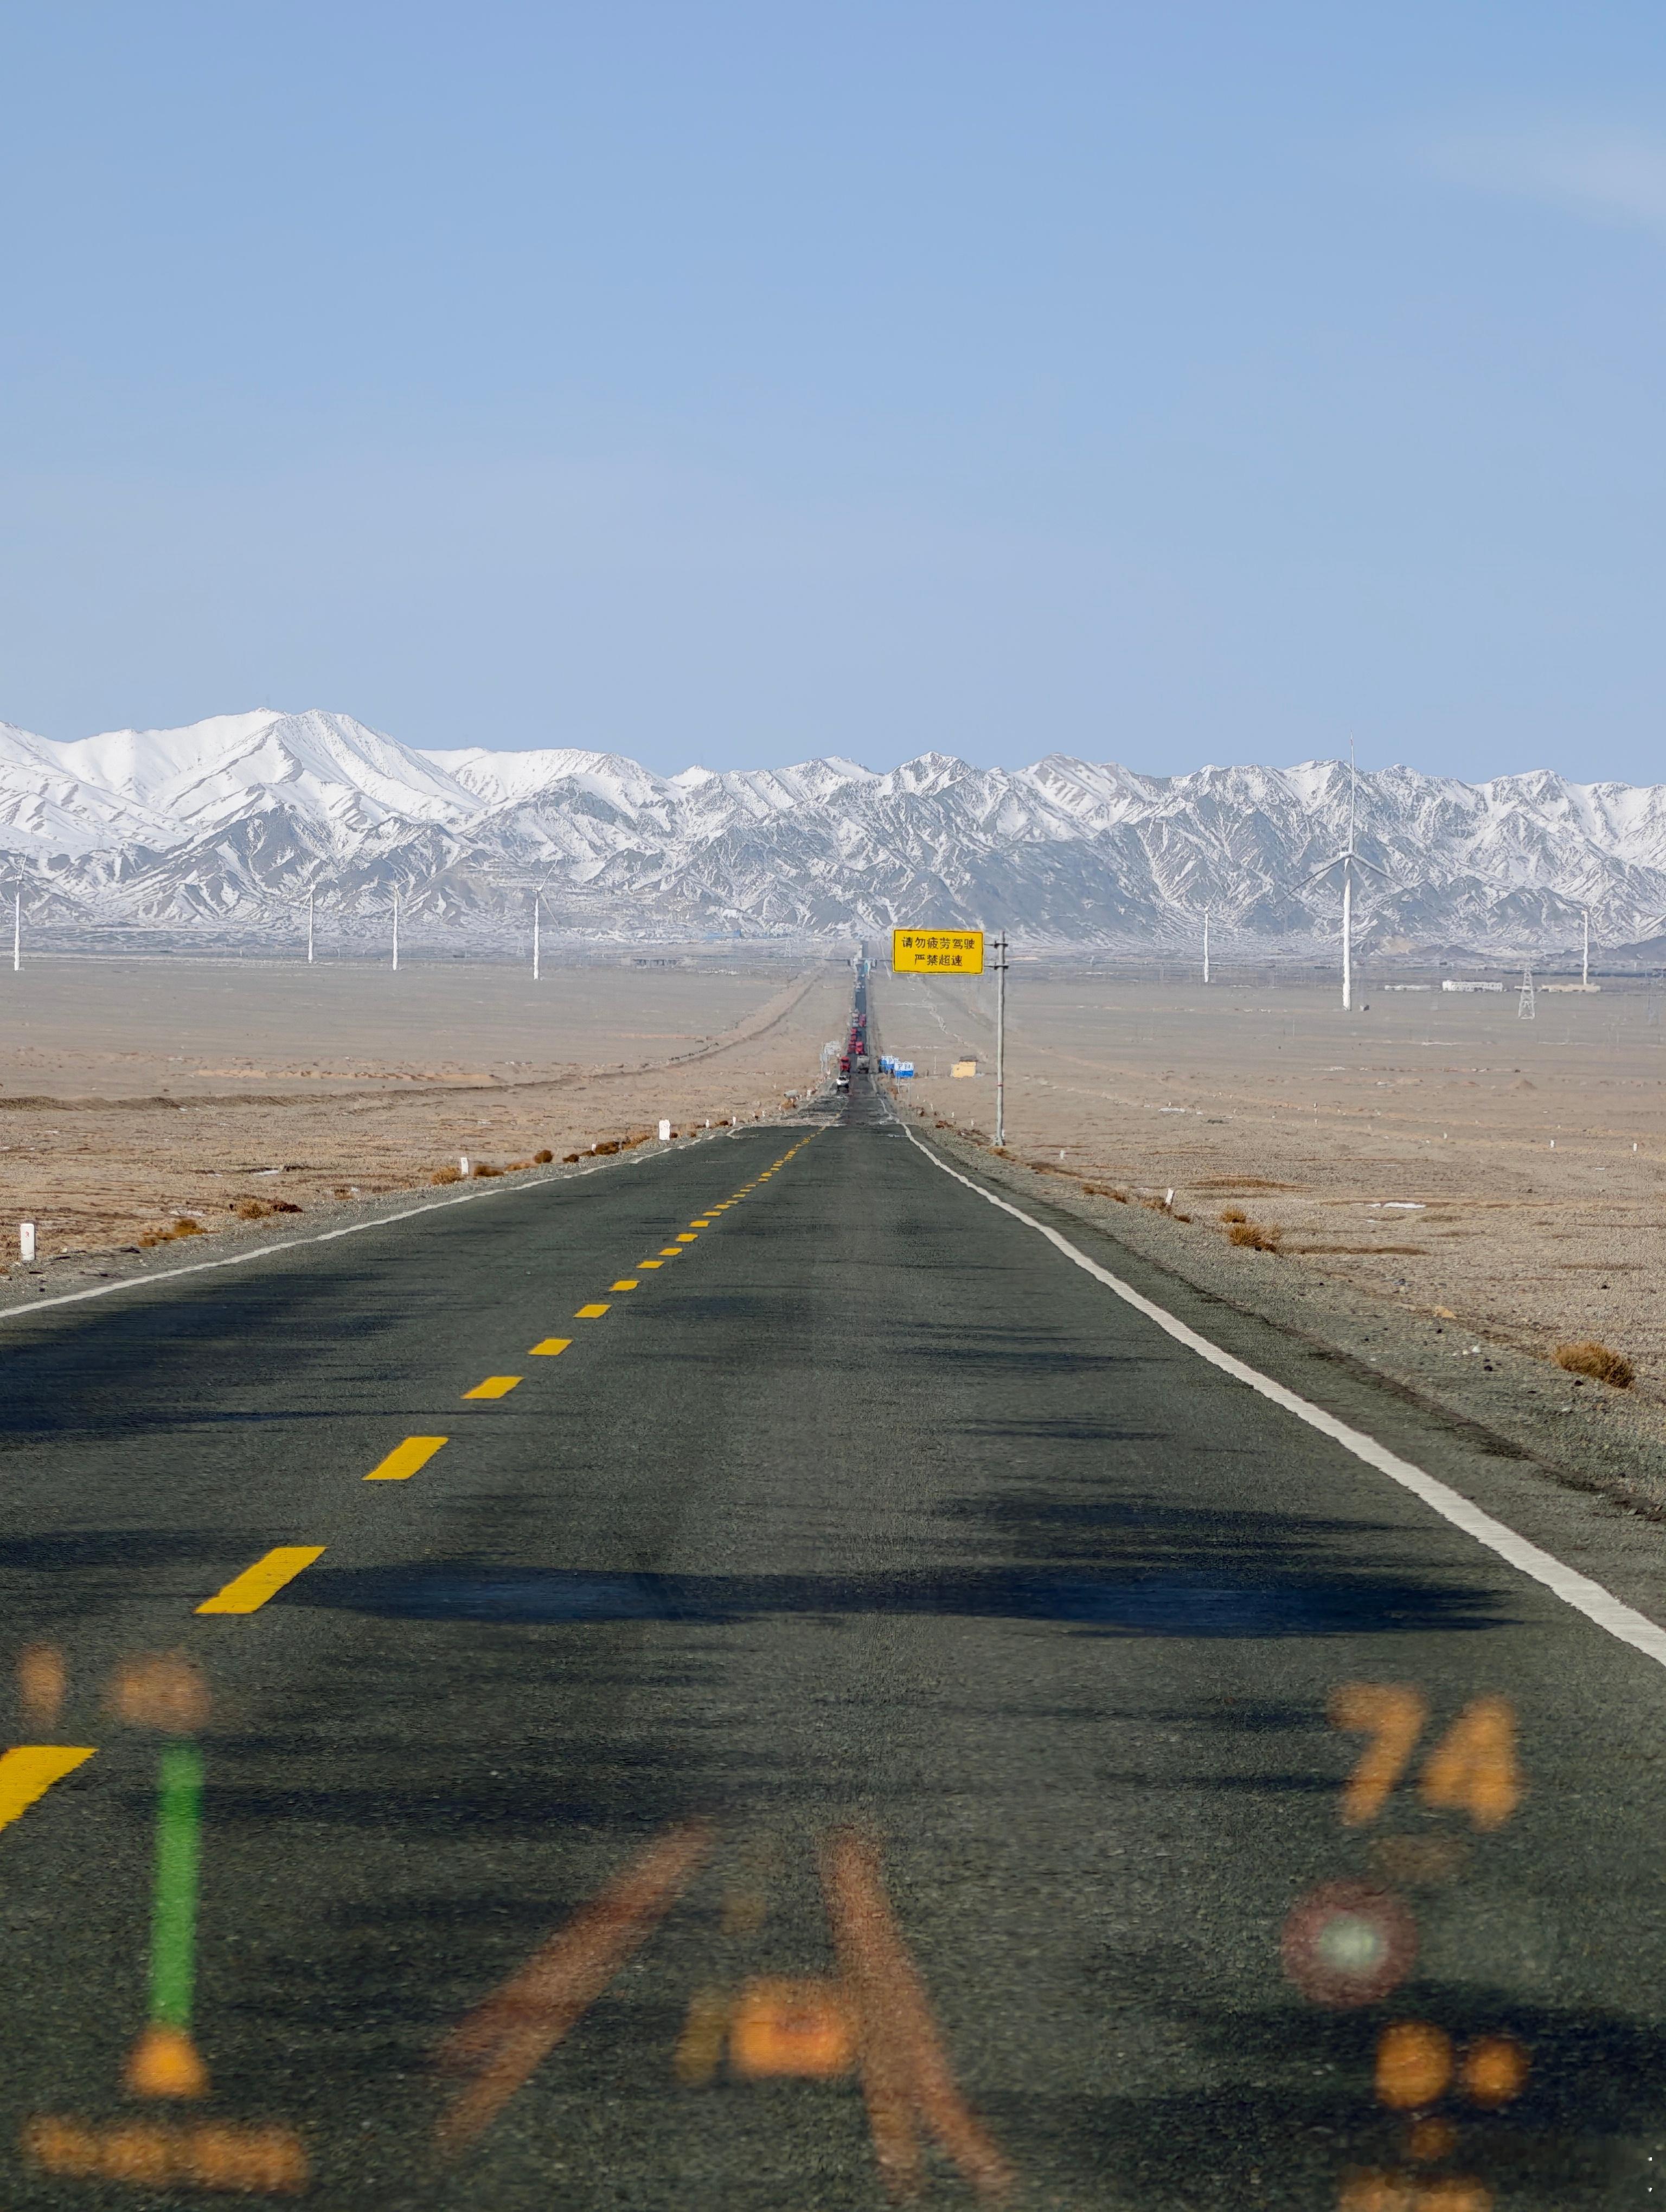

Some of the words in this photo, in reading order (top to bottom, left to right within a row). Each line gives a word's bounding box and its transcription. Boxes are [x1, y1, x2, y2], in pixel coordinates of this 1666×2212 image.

[901, 937, 975, 949] 请勿疲劳驾驶
[914, 954, 963, 967] 严禁超速
[1329, 1682, 1523, 1829] 74
